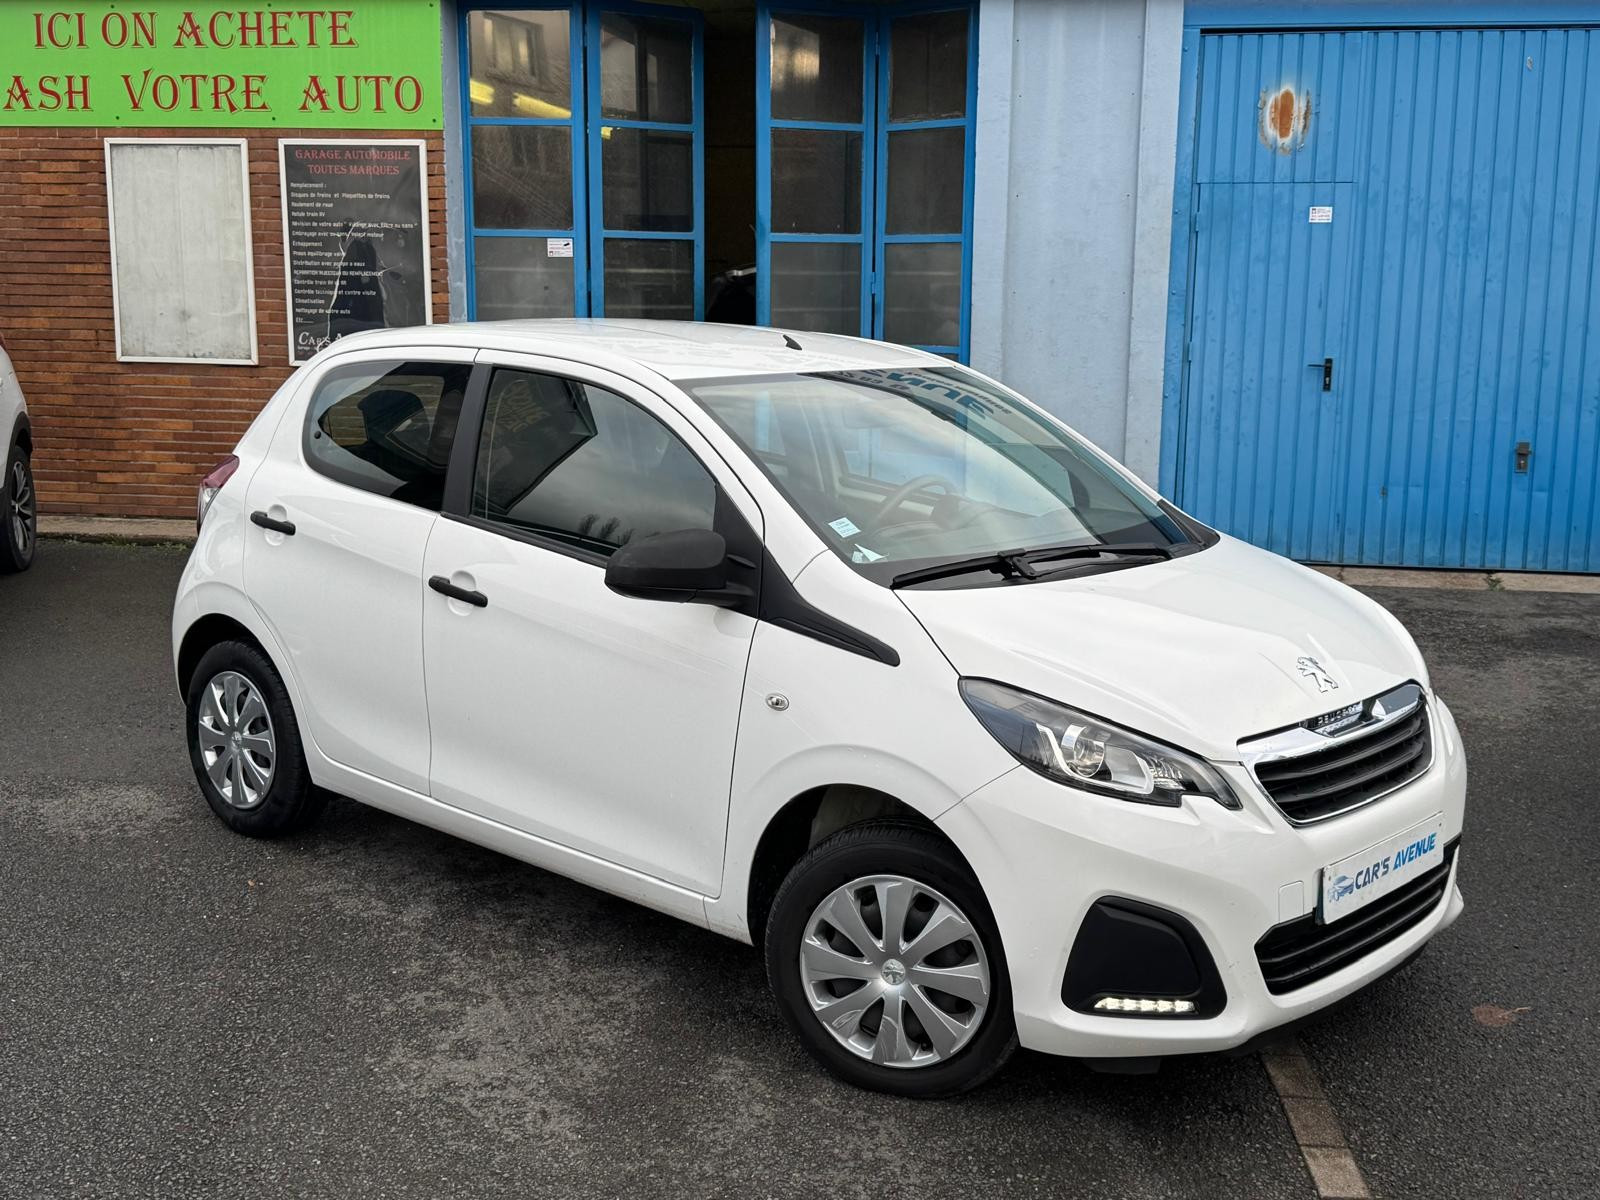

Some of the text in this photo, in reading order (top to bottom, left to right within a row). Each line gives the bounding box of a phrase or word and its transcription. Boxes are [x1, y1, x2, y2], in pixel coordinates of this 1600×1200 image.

[33, 10, 359, 49] ICI ON ACHETE
[120, 67, 272, 114] VOTRE
[298, 75, 424, 114] AUTO
[295, 149, 411, 161] GARAGE AUTOMOBILE
[307, 164, 400, 175] TOUTES MARQUES
[1354, 832, 1437, 890] CAR'S AVENUE
